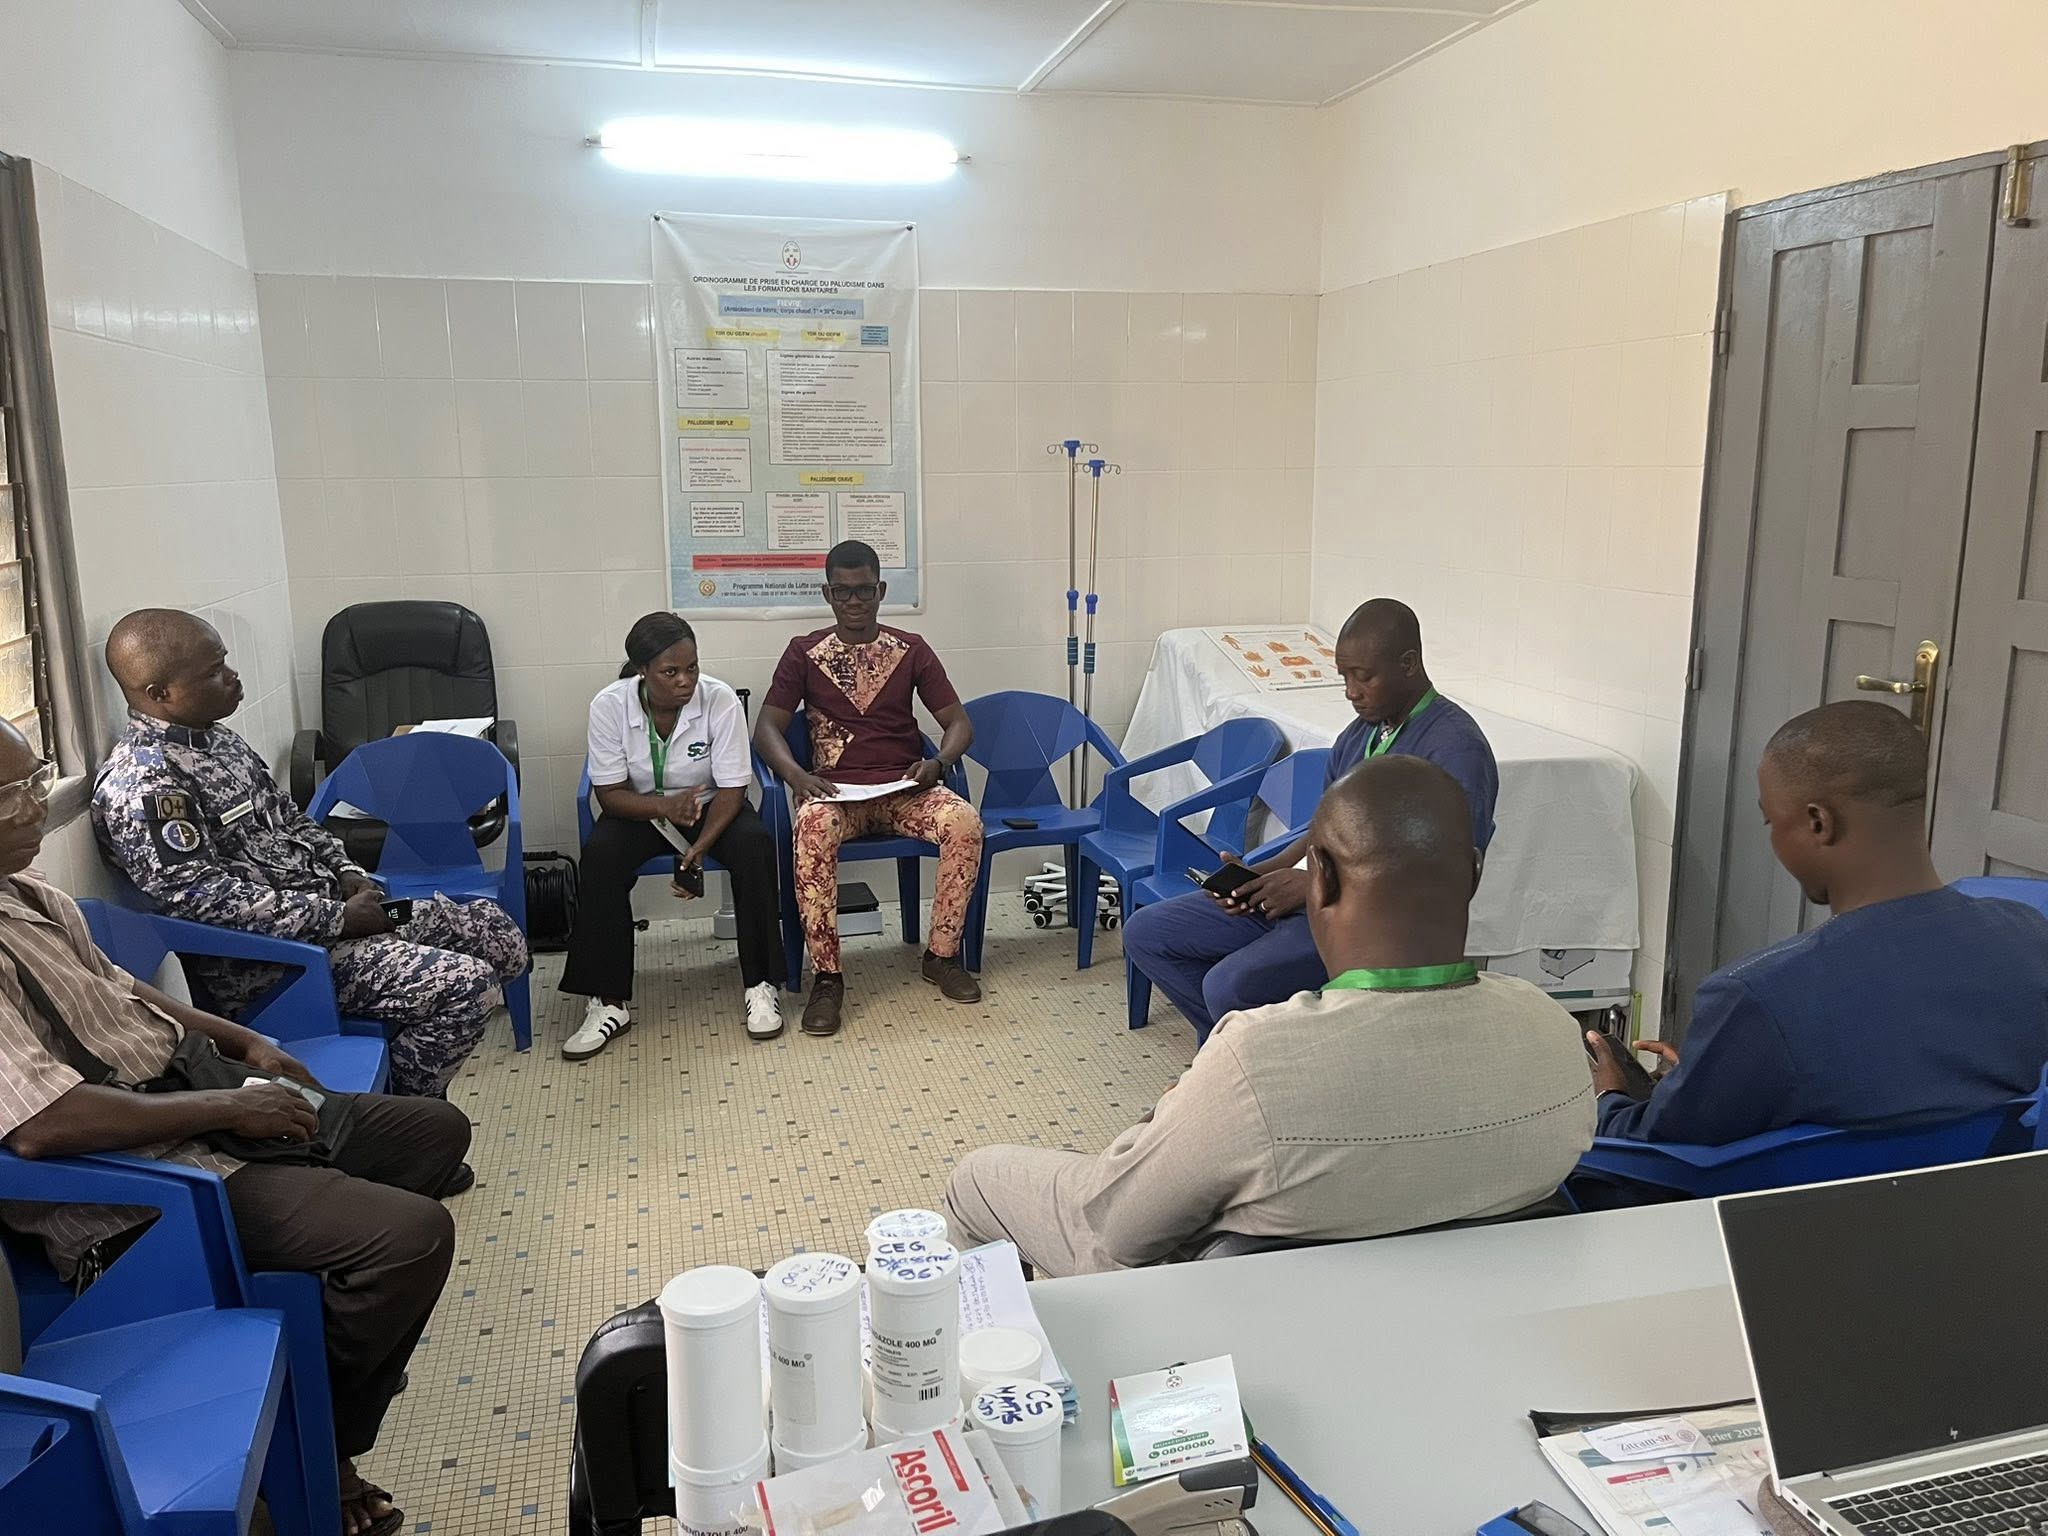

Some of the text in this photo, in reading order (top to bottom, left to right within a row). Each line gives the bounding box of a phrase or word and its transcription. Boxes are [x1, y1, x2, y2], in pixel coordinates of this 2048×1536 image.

[693, 276, 748, 284] ORDINOGRAMME
[791, 279, 818, 287] CHARGE
[732, 582, 764, 590] Programme
[905, 1340, 921, 1348] 400
[922, 1336, 937, 1346] MG
[791, 1360, 806, 1368] MG
[1025, 1390, 1053, 1415] CS
[891, 1449, 957, 1534] Ascoril
